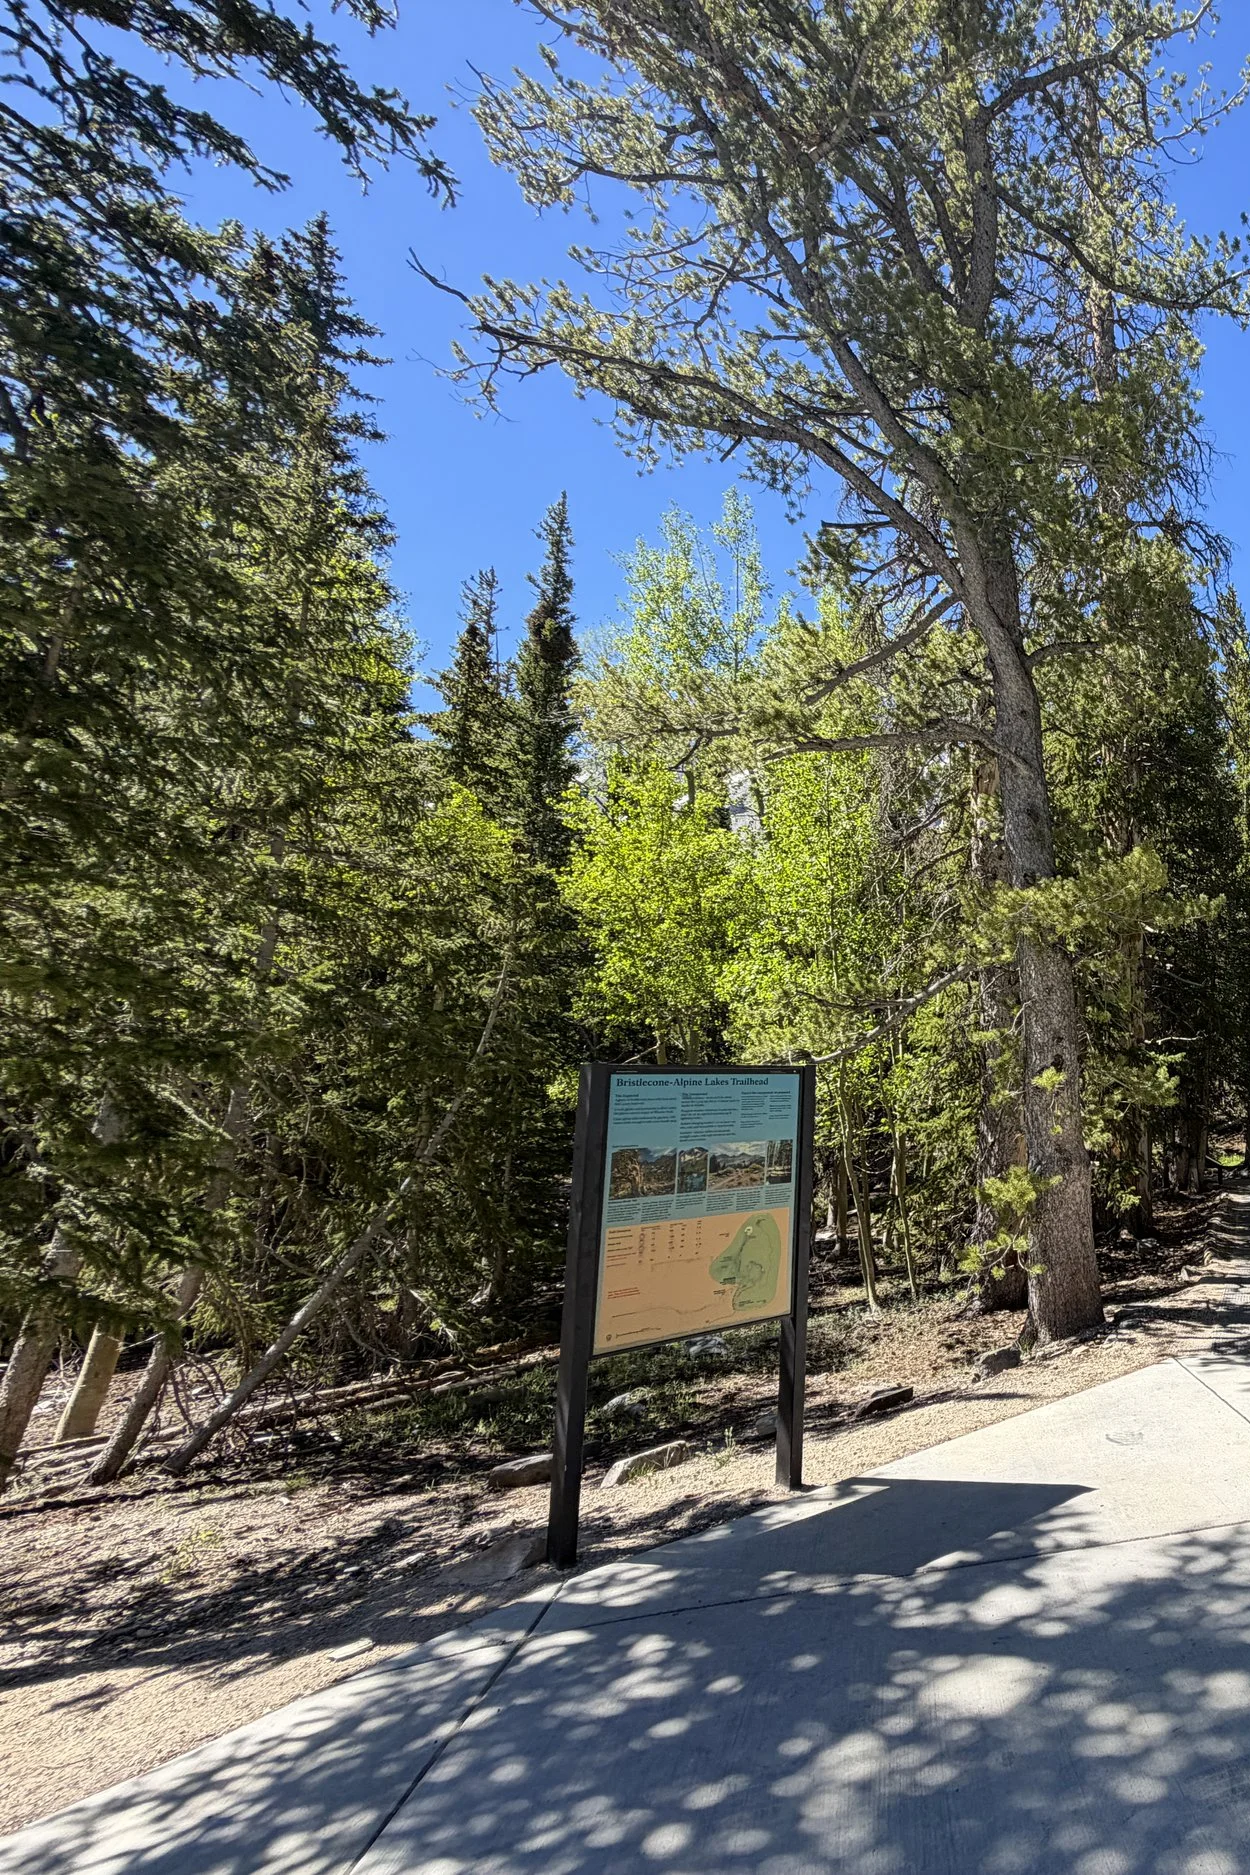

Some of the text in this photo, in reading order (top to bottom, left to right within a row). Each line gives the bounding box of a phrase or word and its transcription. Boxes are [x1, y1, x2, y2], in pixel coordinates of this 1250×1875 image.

[616, 1077, 769, 1088] Bristlecone-Alpine Lakes Trailhead
